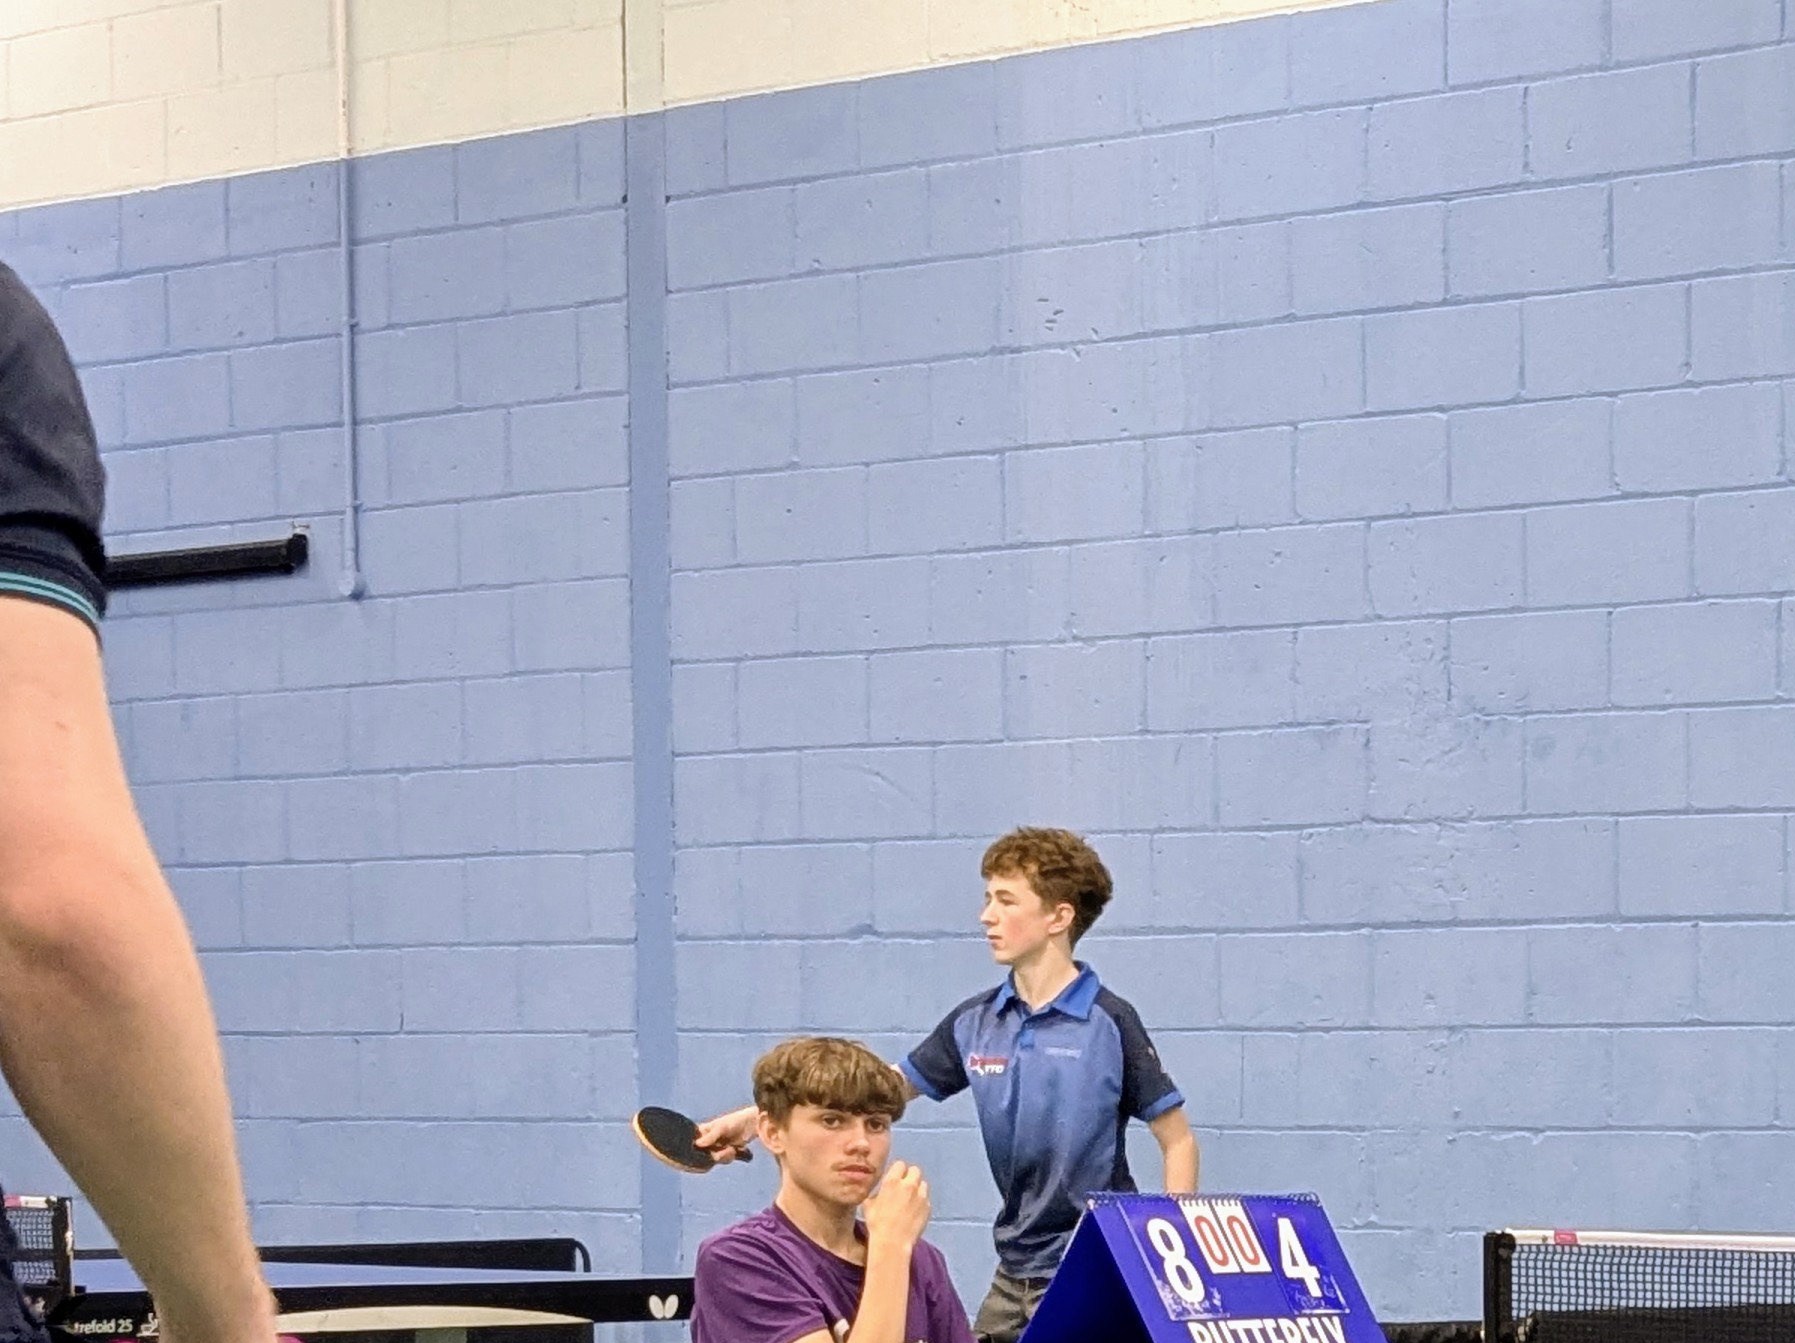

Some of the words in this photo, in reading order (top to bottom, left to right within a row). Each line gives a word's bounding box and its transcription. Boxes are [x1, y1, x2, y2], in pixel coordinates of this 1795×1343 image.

[1147, 1217, 1205, 1304] 8
[1277, 1217, 1323, 1297] 4
[117, 1318, 133, 1333] 25
